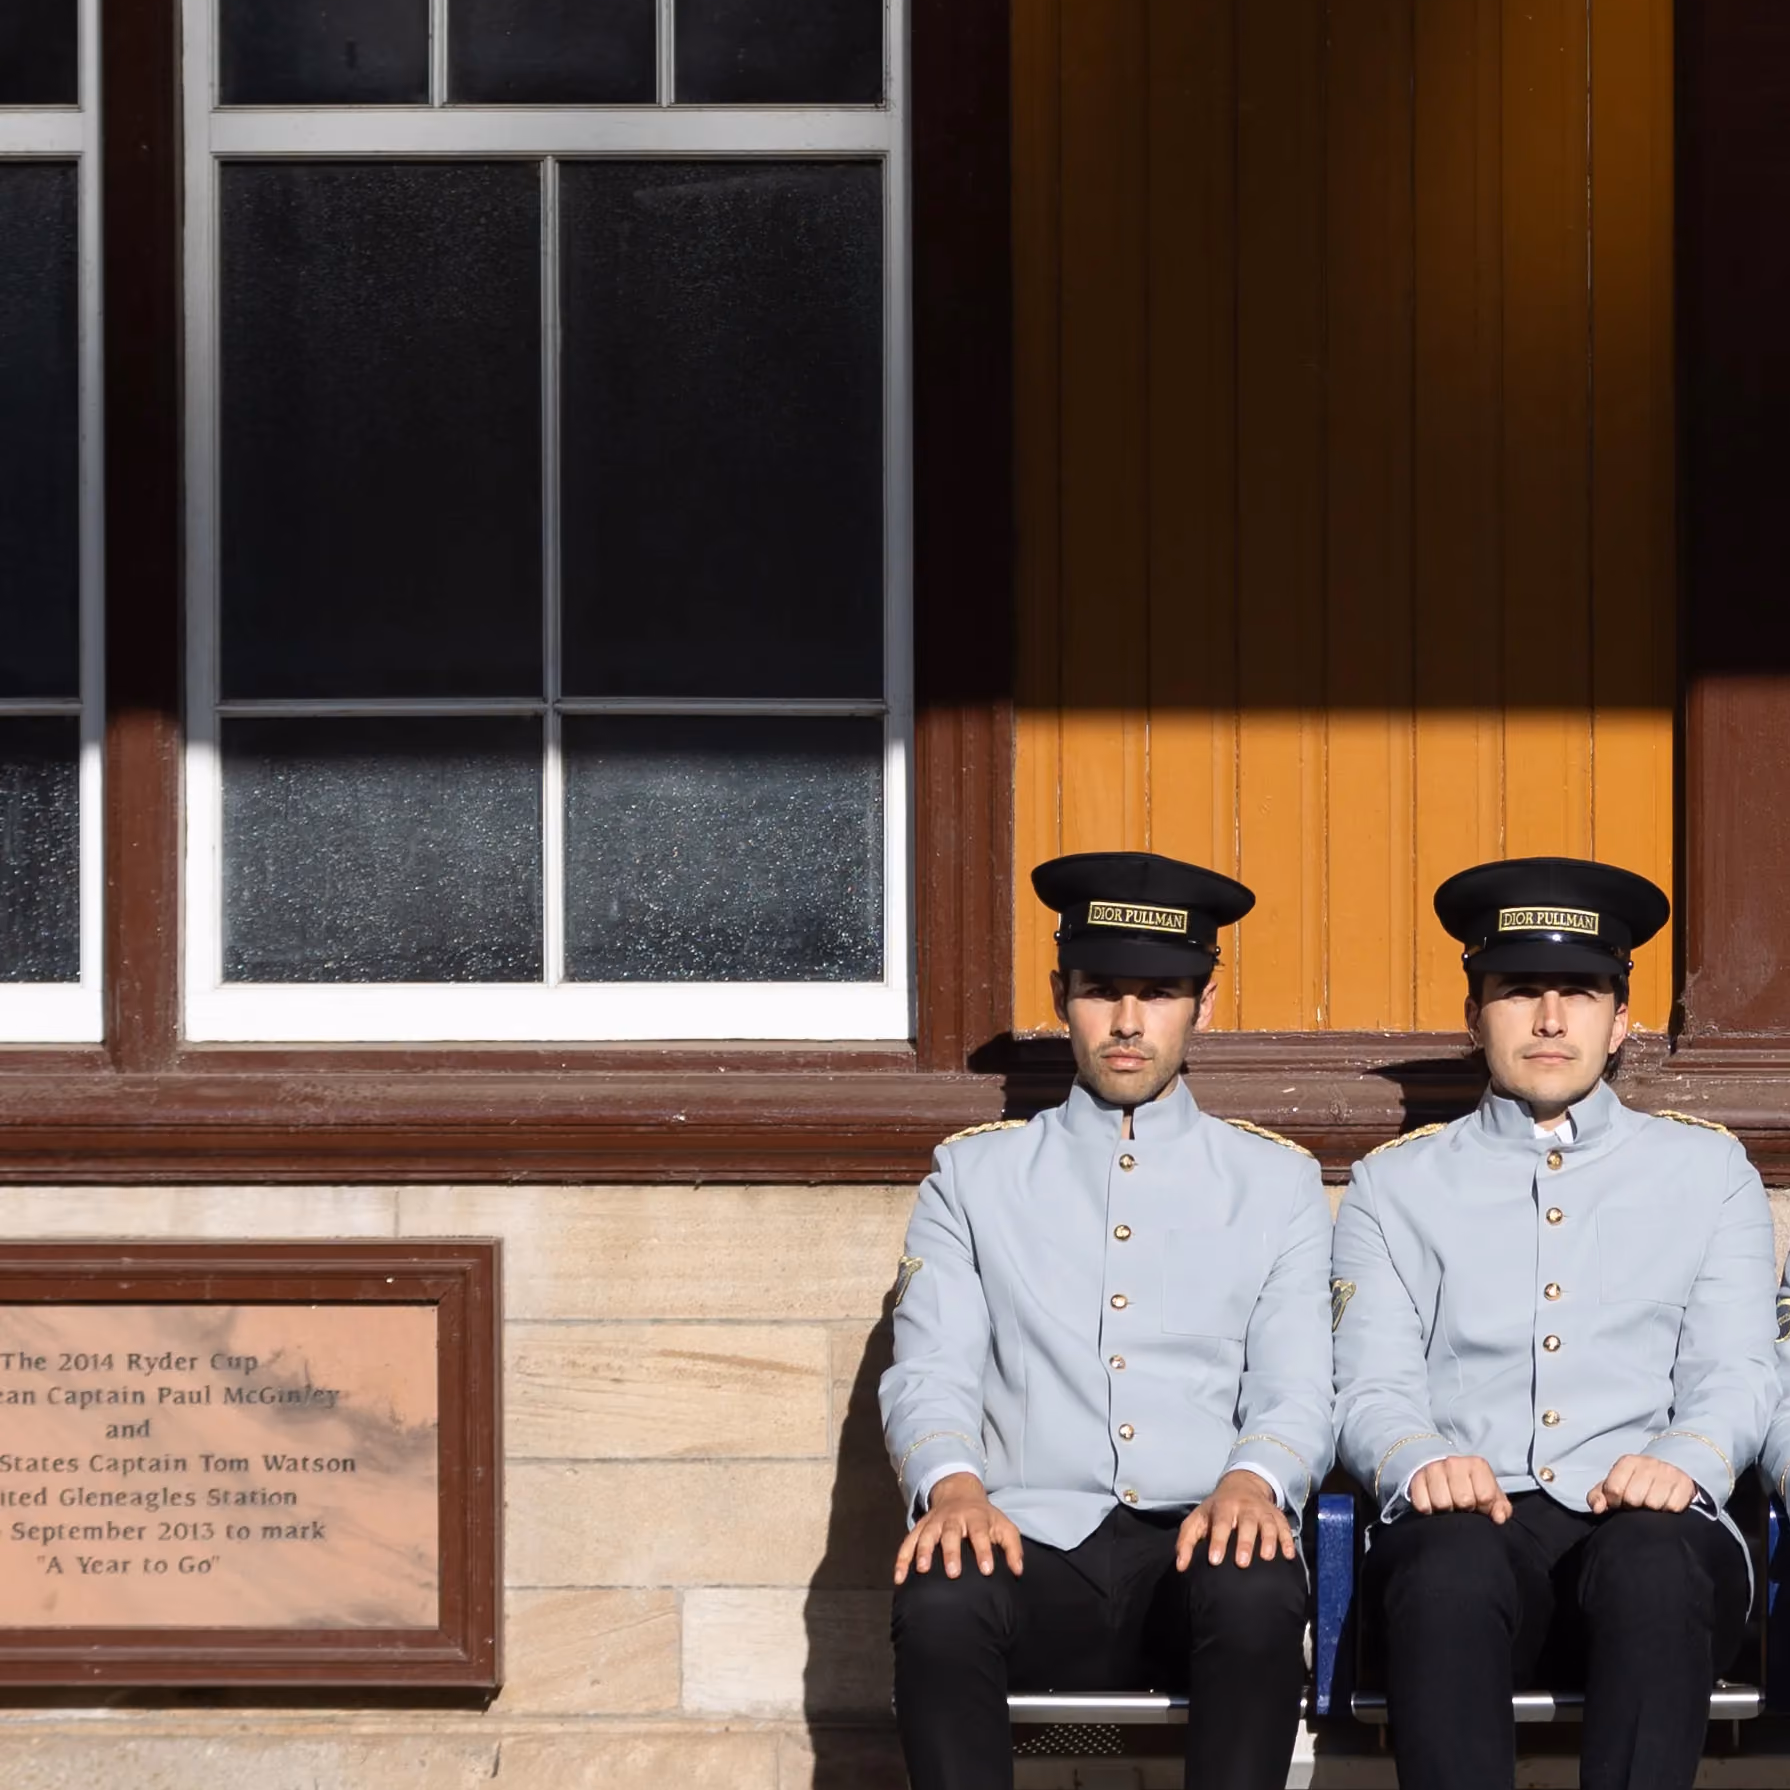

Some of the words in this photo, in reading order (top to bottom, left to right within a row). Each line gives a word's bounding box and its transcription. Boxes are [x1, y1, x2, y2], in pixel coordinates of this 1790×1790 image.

[1093, 907, 1122, 921] DIOR
[1125, 909, 1183, 928] PULLMAN
[1504, 912, 1534, 926] DIOR
[1537, 912, 1594, 929] PULLMAN
[2, 1352, 47, 1371] The
[58, 1353, 114, 1371] 2014
[127, 1352, 199, 1377] Ryder
[210, 1353, 258, 1376] Cup
[47, 1386, 146, 1409] Captain
[157, 1385, 211, 1405] Paul
[223, 1385, 340, 1409] McGinley
[105, 1419, 151, 1439] and
[0, 1454, 79, 1473] States
[90, 1454, 188, 1478] Captain
[199, 1454, 250, 1473] Tom
[262, 1454, 357, 1473] Watson
[59, 1487, 196, 1513] Gleneagles
[206, 1488, 298, 1507] Station
[10, 1521, 147, 1545] September
[158, 1522, 214, 1540] 2013
[226, 1523, 251, 1540] to
[261, 1521, 326, 1540] mark
[76, 1556, 131, 1574] Year
[143, 1557, 168, 1574] to
